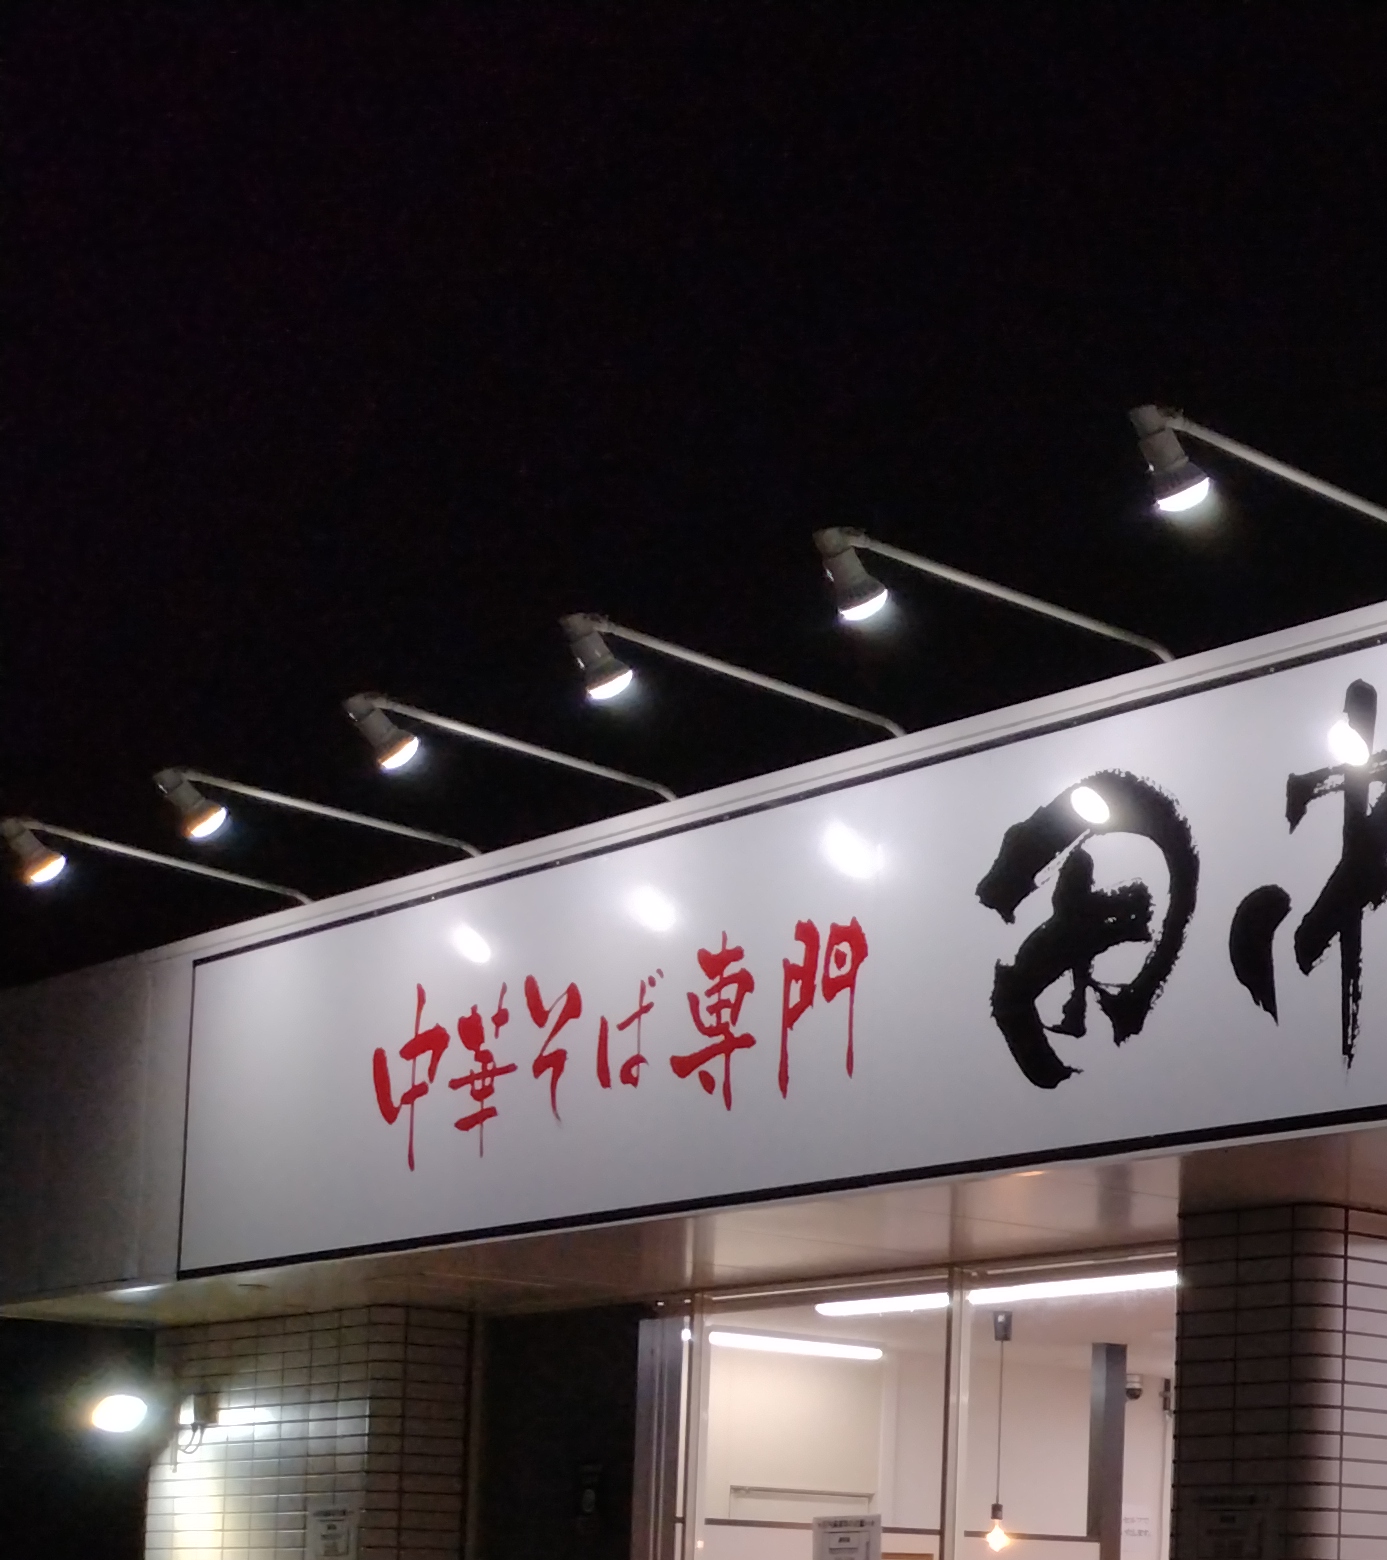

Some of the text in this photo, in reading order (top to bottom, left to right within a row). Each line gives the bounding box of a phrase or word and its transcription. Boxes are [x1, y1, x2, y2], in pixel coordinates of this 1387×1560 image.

[372, 916, 870, 1171] 中華そば専門
